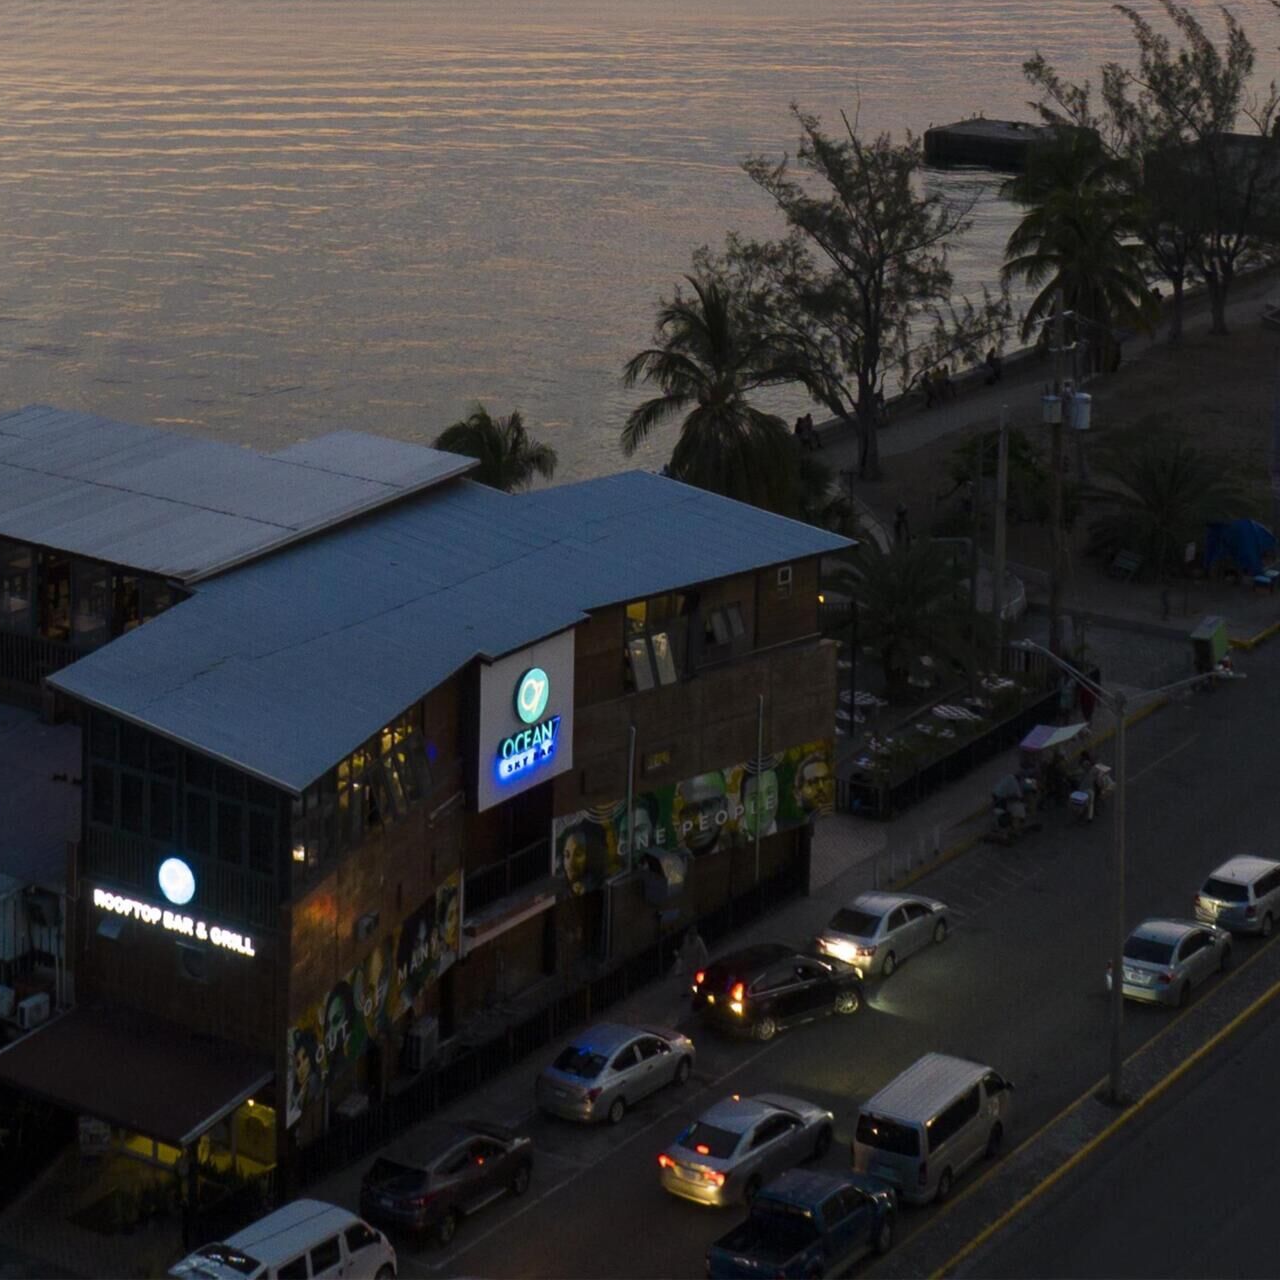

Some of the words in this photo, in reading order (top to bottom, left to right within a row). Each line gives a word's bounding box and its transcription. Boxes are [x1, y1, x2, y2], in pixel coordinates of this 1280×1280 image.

[507, 756, 529, 773] SKY
[533, 744, 554, 762] BAR
[617, 826, 666, 856] ONE
[682, 796, 775, 835] PEOPLE
[94, 889, 161, 924] ROOFTOP
[163, 910, 193, 936] BAR
[196, 921, 208, 940] &
[210, 926, 255, 957] GRILL
